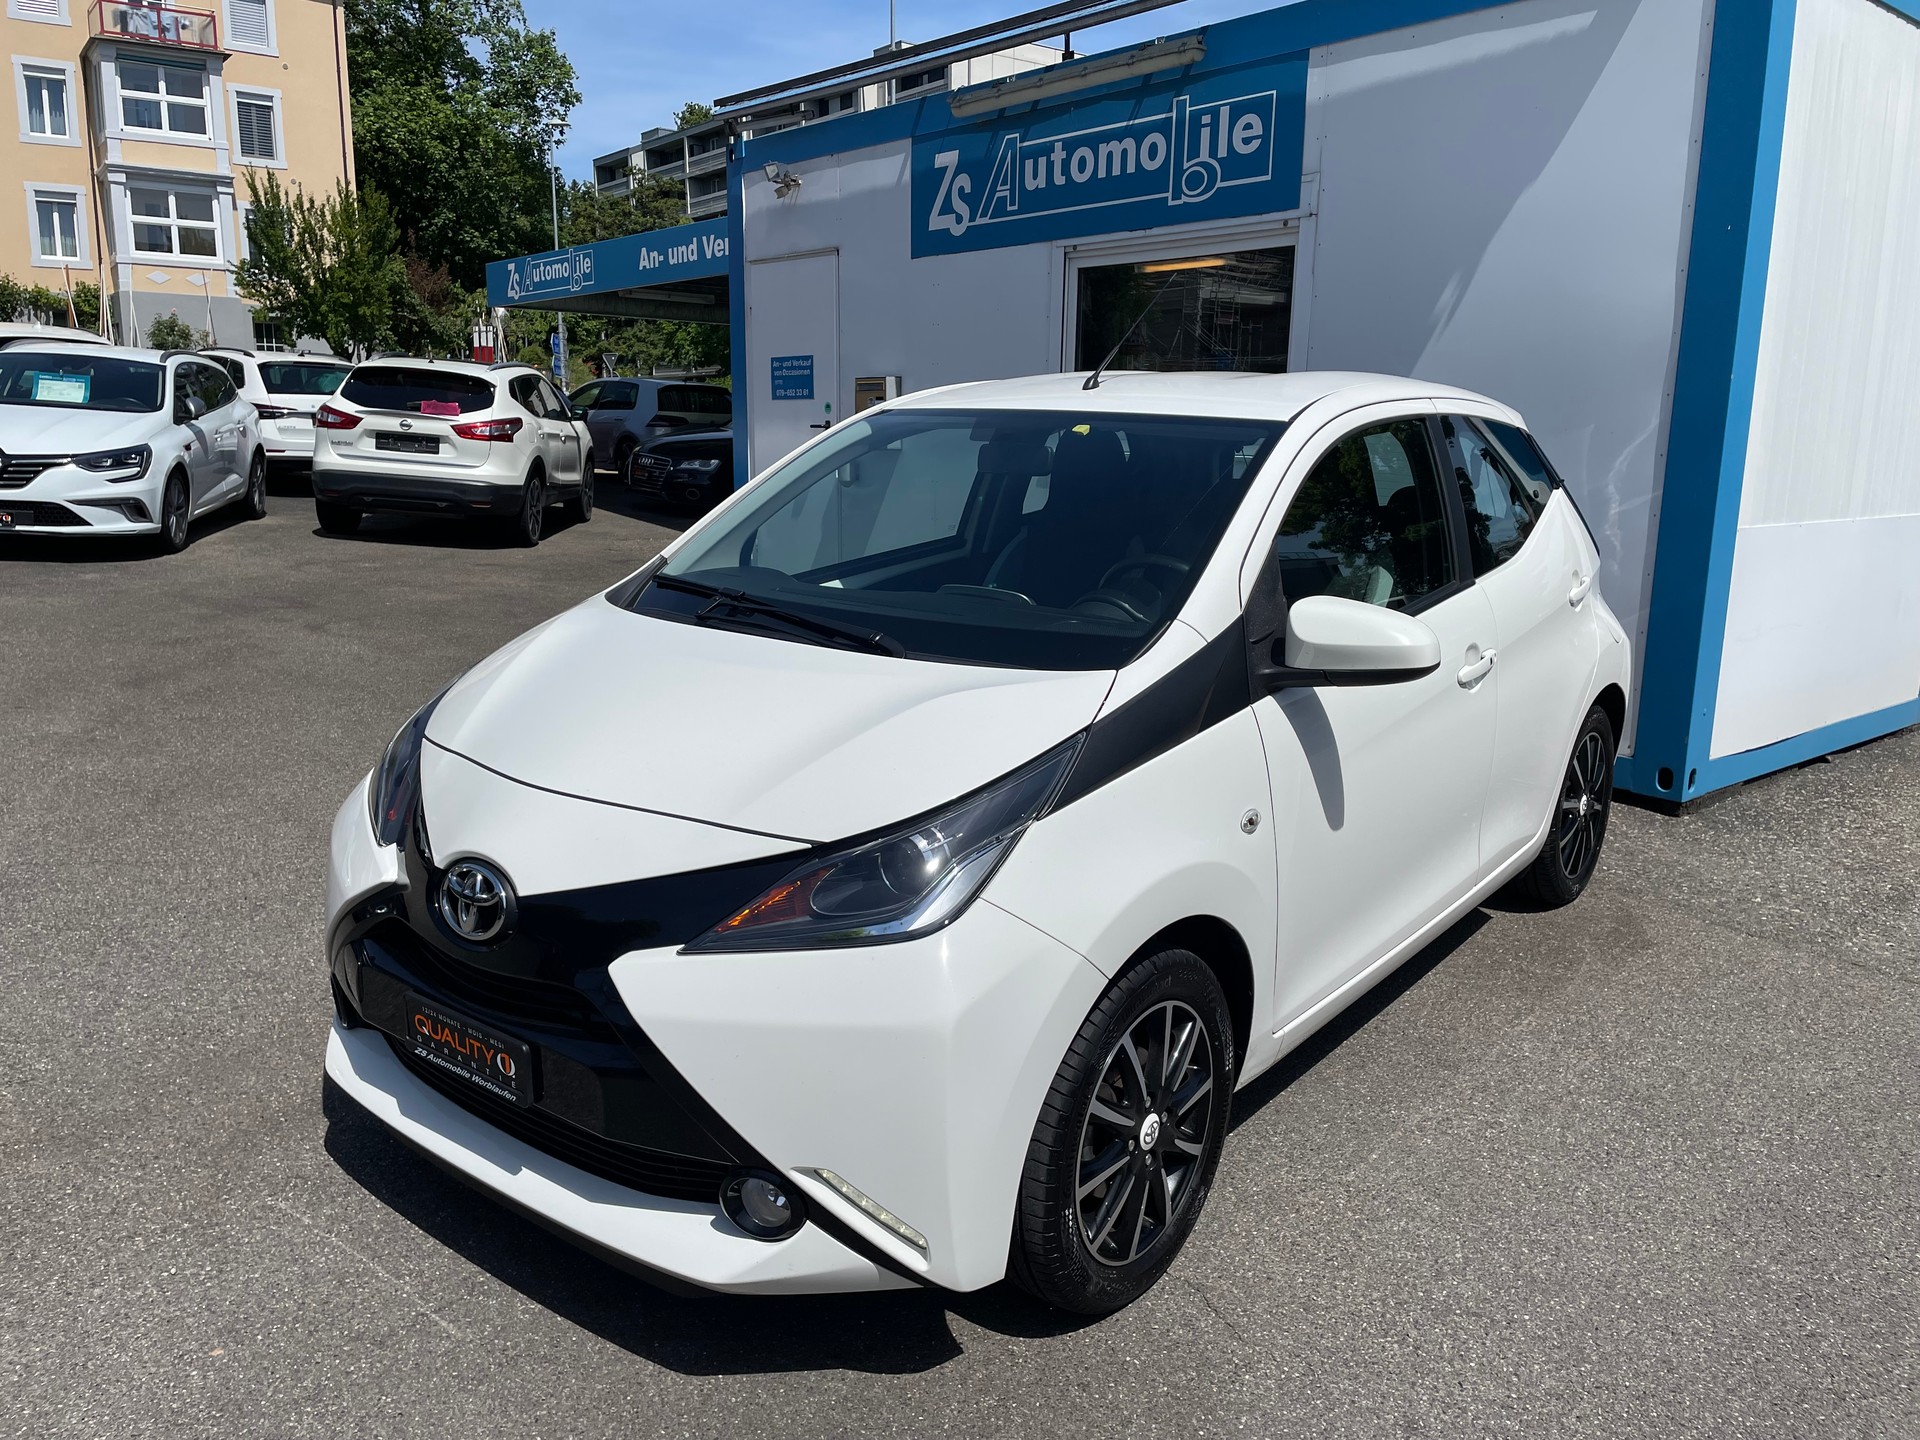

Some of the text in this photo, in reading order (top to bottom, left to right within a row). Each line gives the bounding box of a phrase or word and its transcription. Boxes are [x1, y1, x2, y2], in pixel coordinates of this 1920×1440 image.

[976, 94, 1264, 223] Automobile
[521, 249, 591, 294] Automobile
[638, 247, 664, 271] An-
[668, 238, 698, 266] und
[414, 1014, 494, 1065] QUALITY
[438, 1013, 461, 1029] MONATE
[468, 1025, 483, 1039] MOIS
[414, 1046, 517, 1102] ZS Automobile Worblaufen
